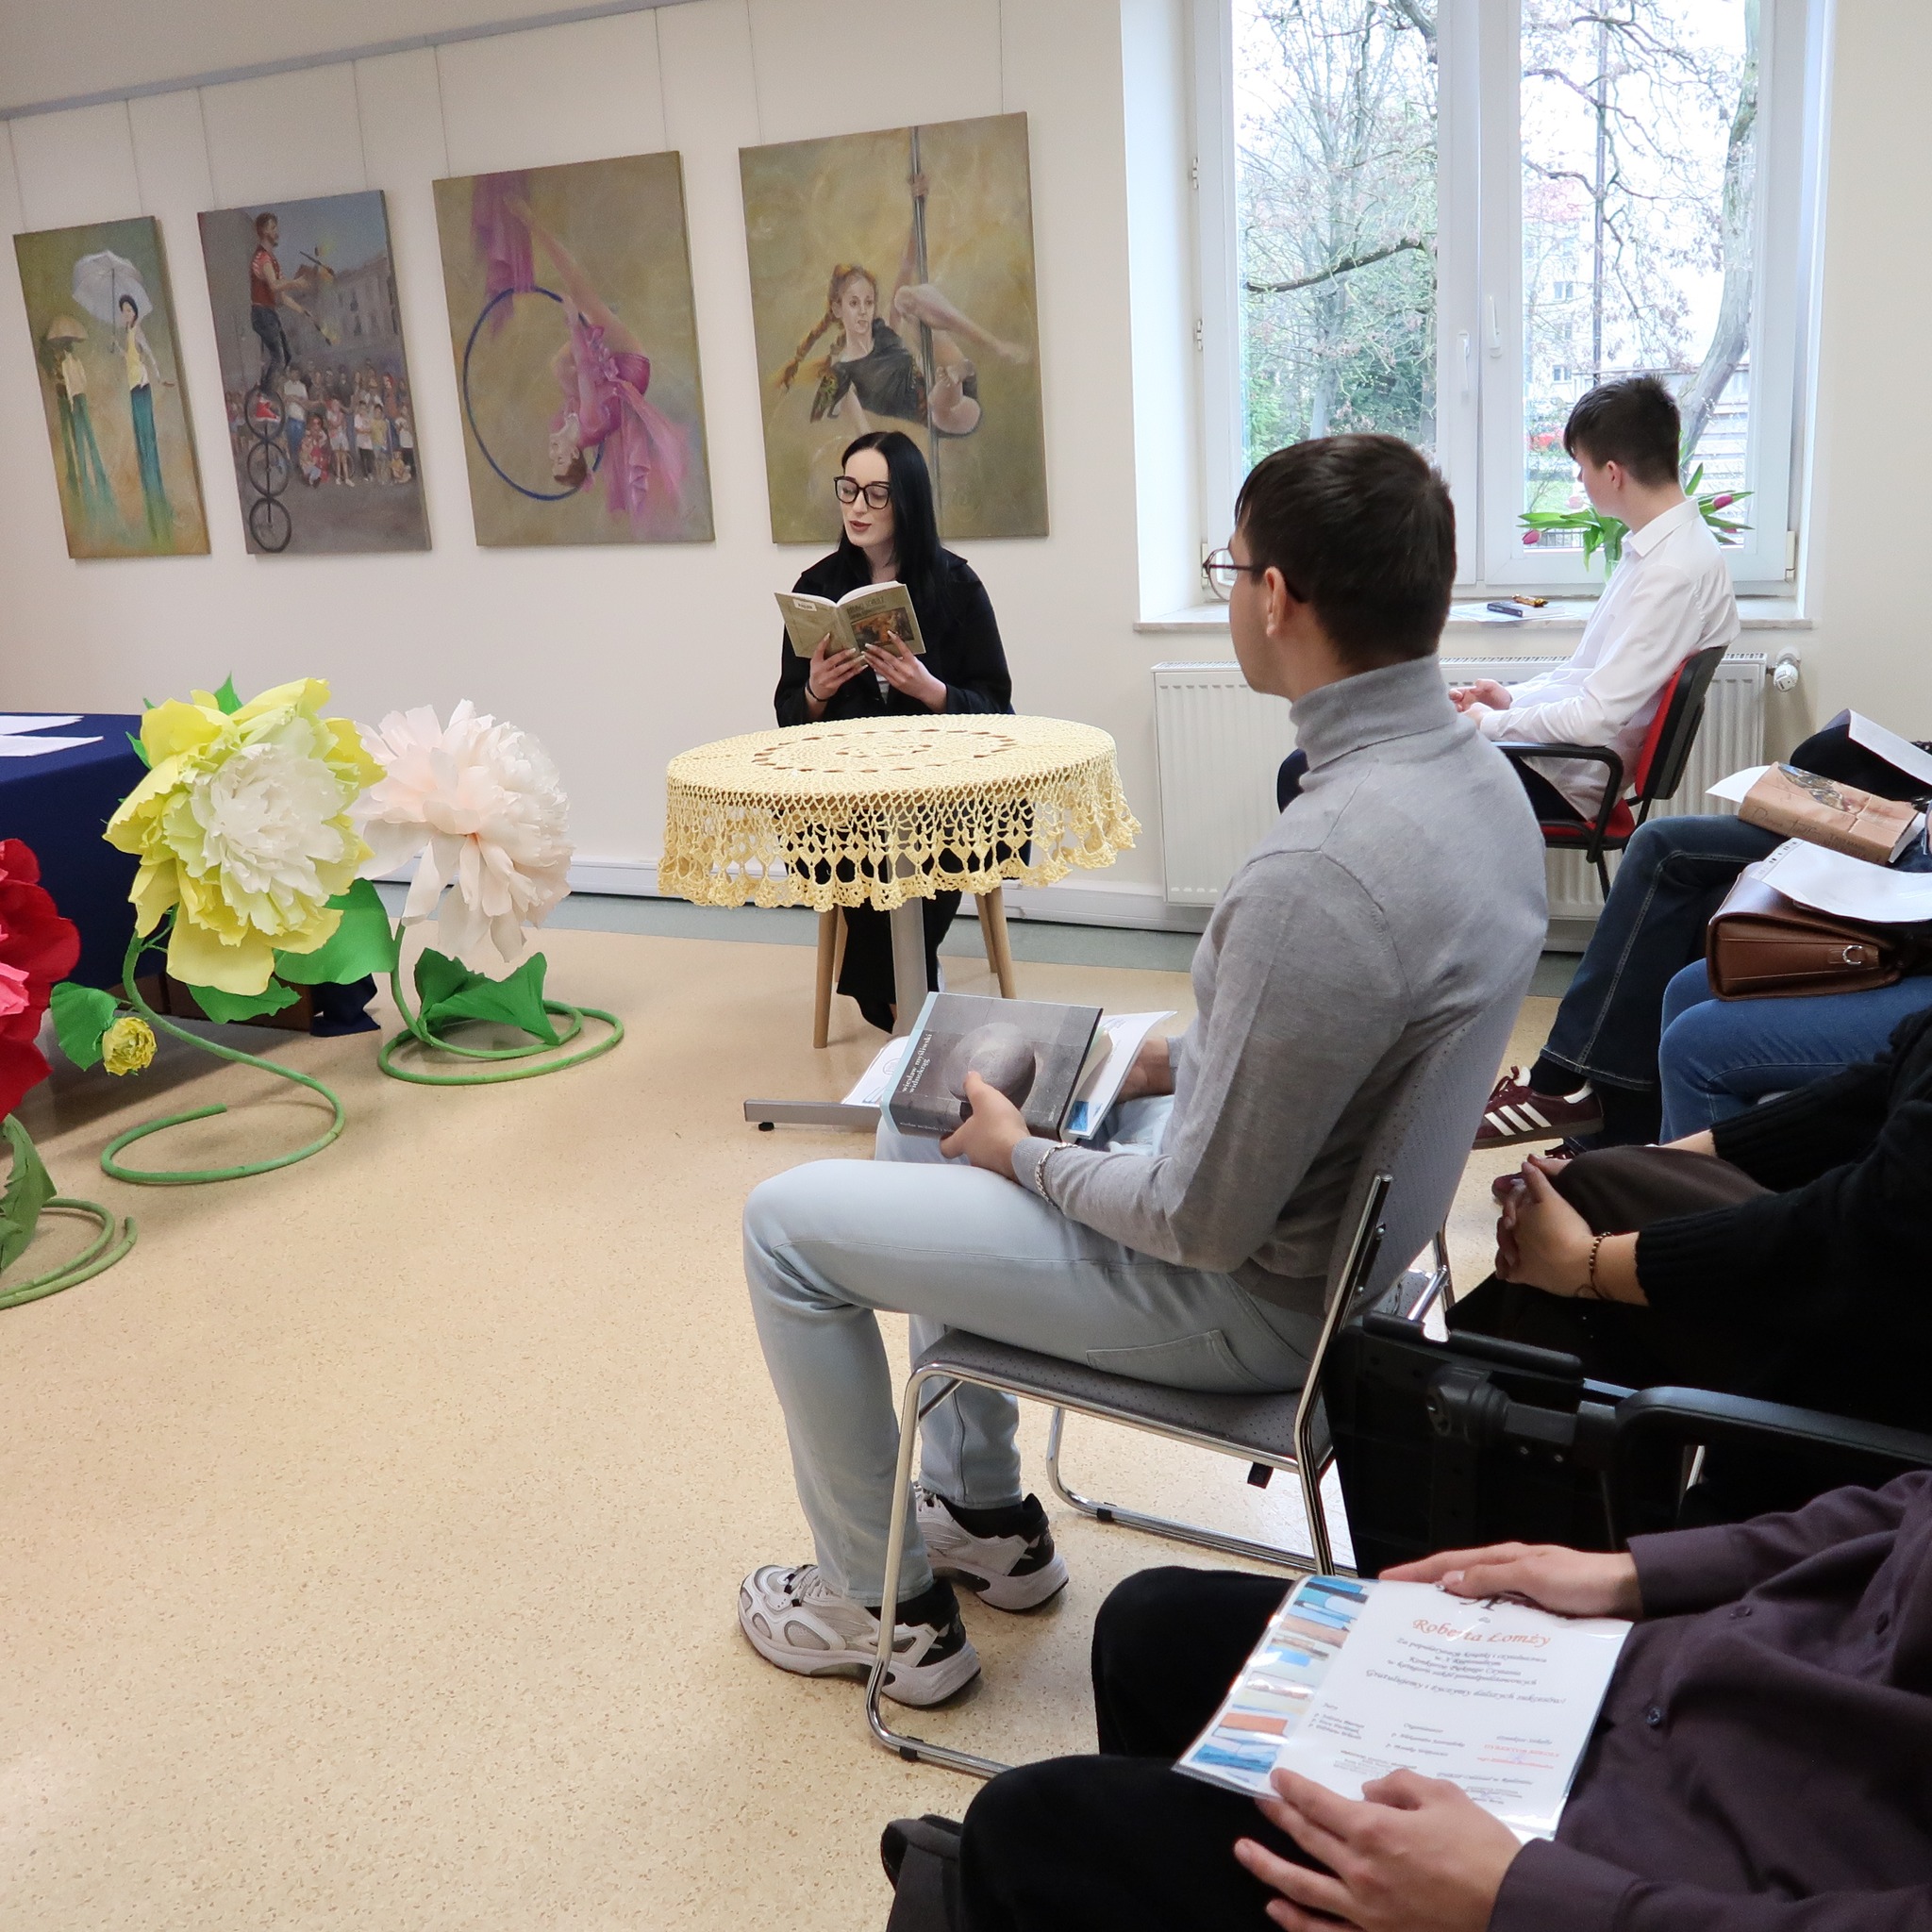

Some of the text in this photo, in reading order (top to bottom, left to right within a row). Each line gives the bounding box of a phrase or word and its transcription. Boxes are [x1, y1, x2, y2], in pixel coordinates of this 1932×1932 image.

[902, 1033, 933, 1093] wiesław myśliwski
[908, 1058, 931, 1093] widnokrąg
[1487, 1632, 1551, 1649] Łomży
[1366, 1669, 1424, 1689] Gratulujemy
